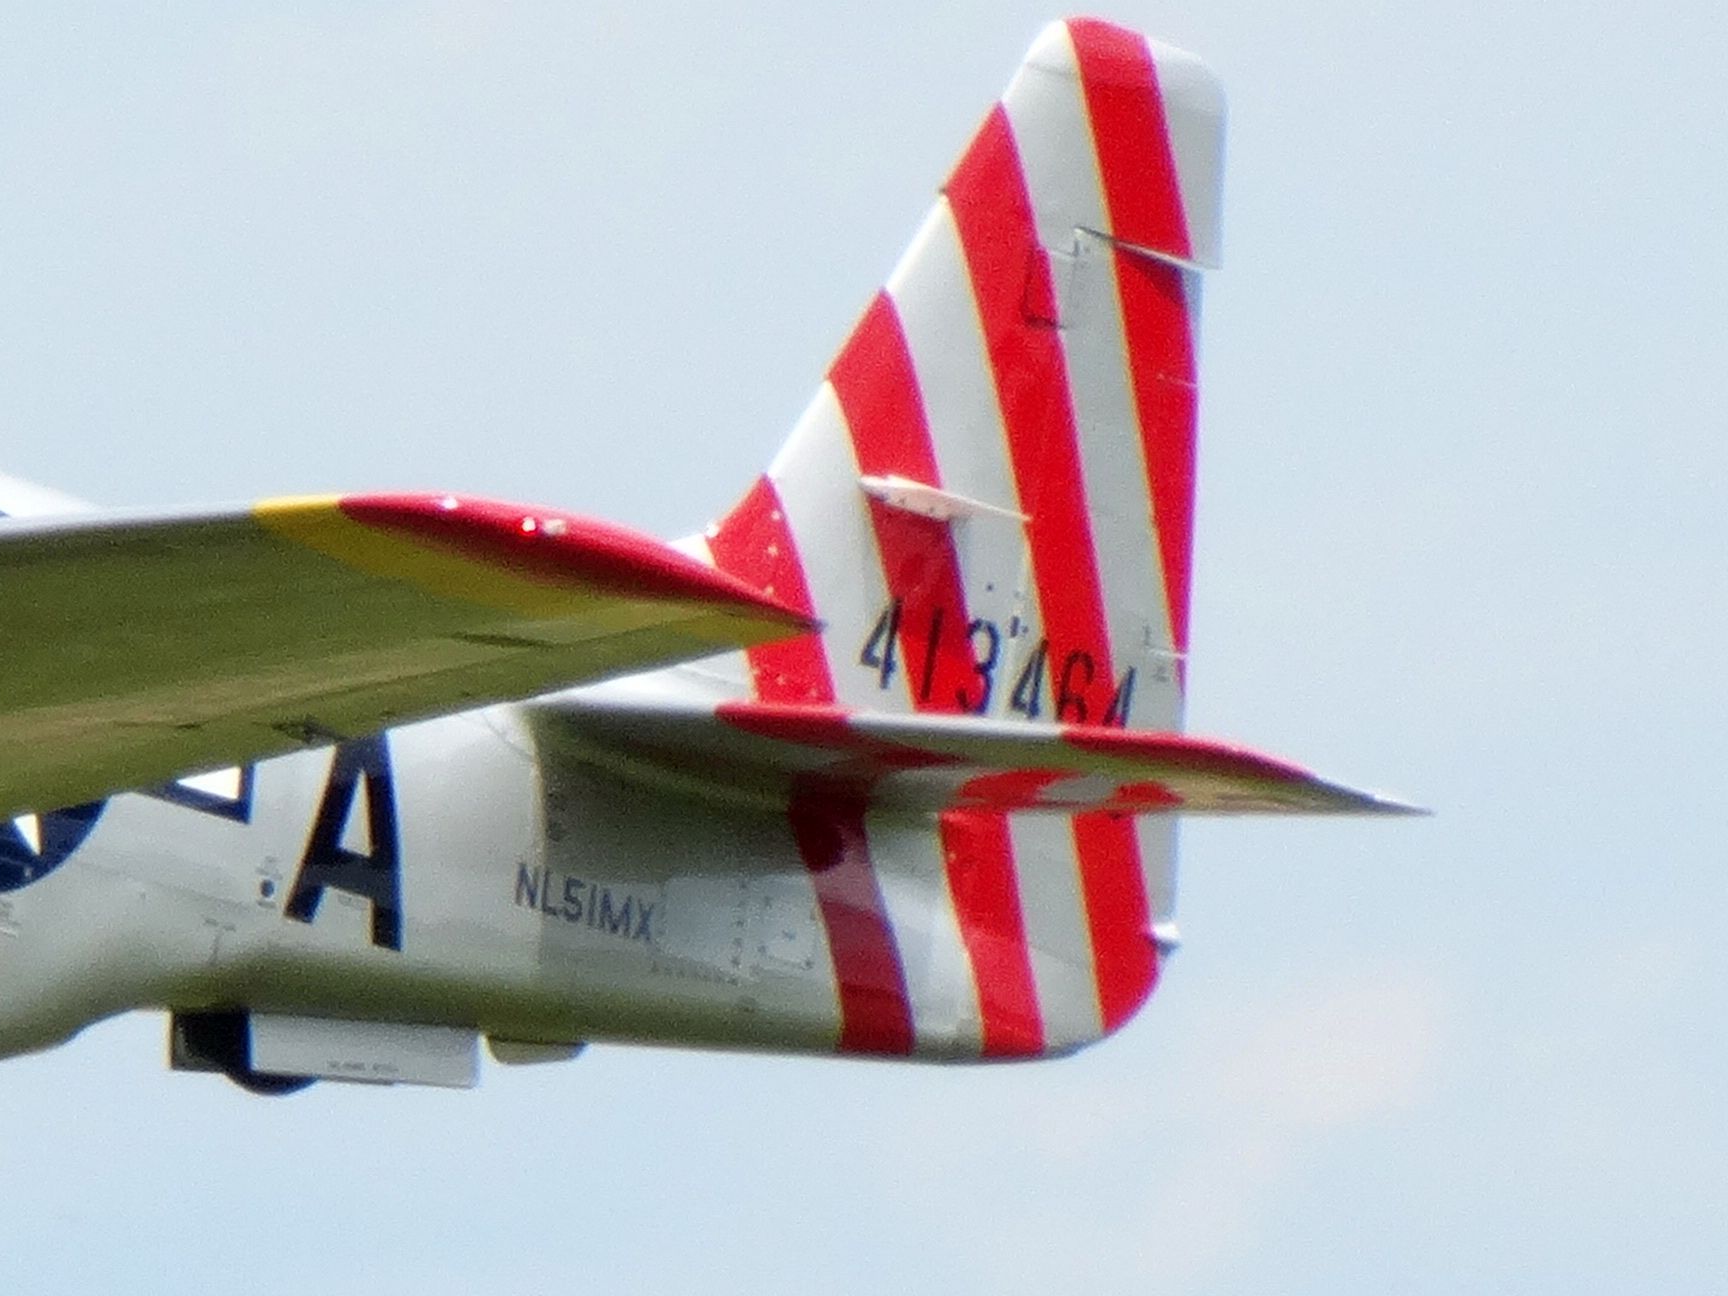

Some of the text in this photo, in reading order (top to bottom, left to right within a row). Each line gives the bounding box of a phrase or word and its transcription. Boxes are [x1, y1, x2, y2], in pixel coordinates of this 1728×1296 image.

[859, 596, 1137, 729] 413464
[283, 732, 403, 952] A
[515, 861, 655, 941] NL51MX
